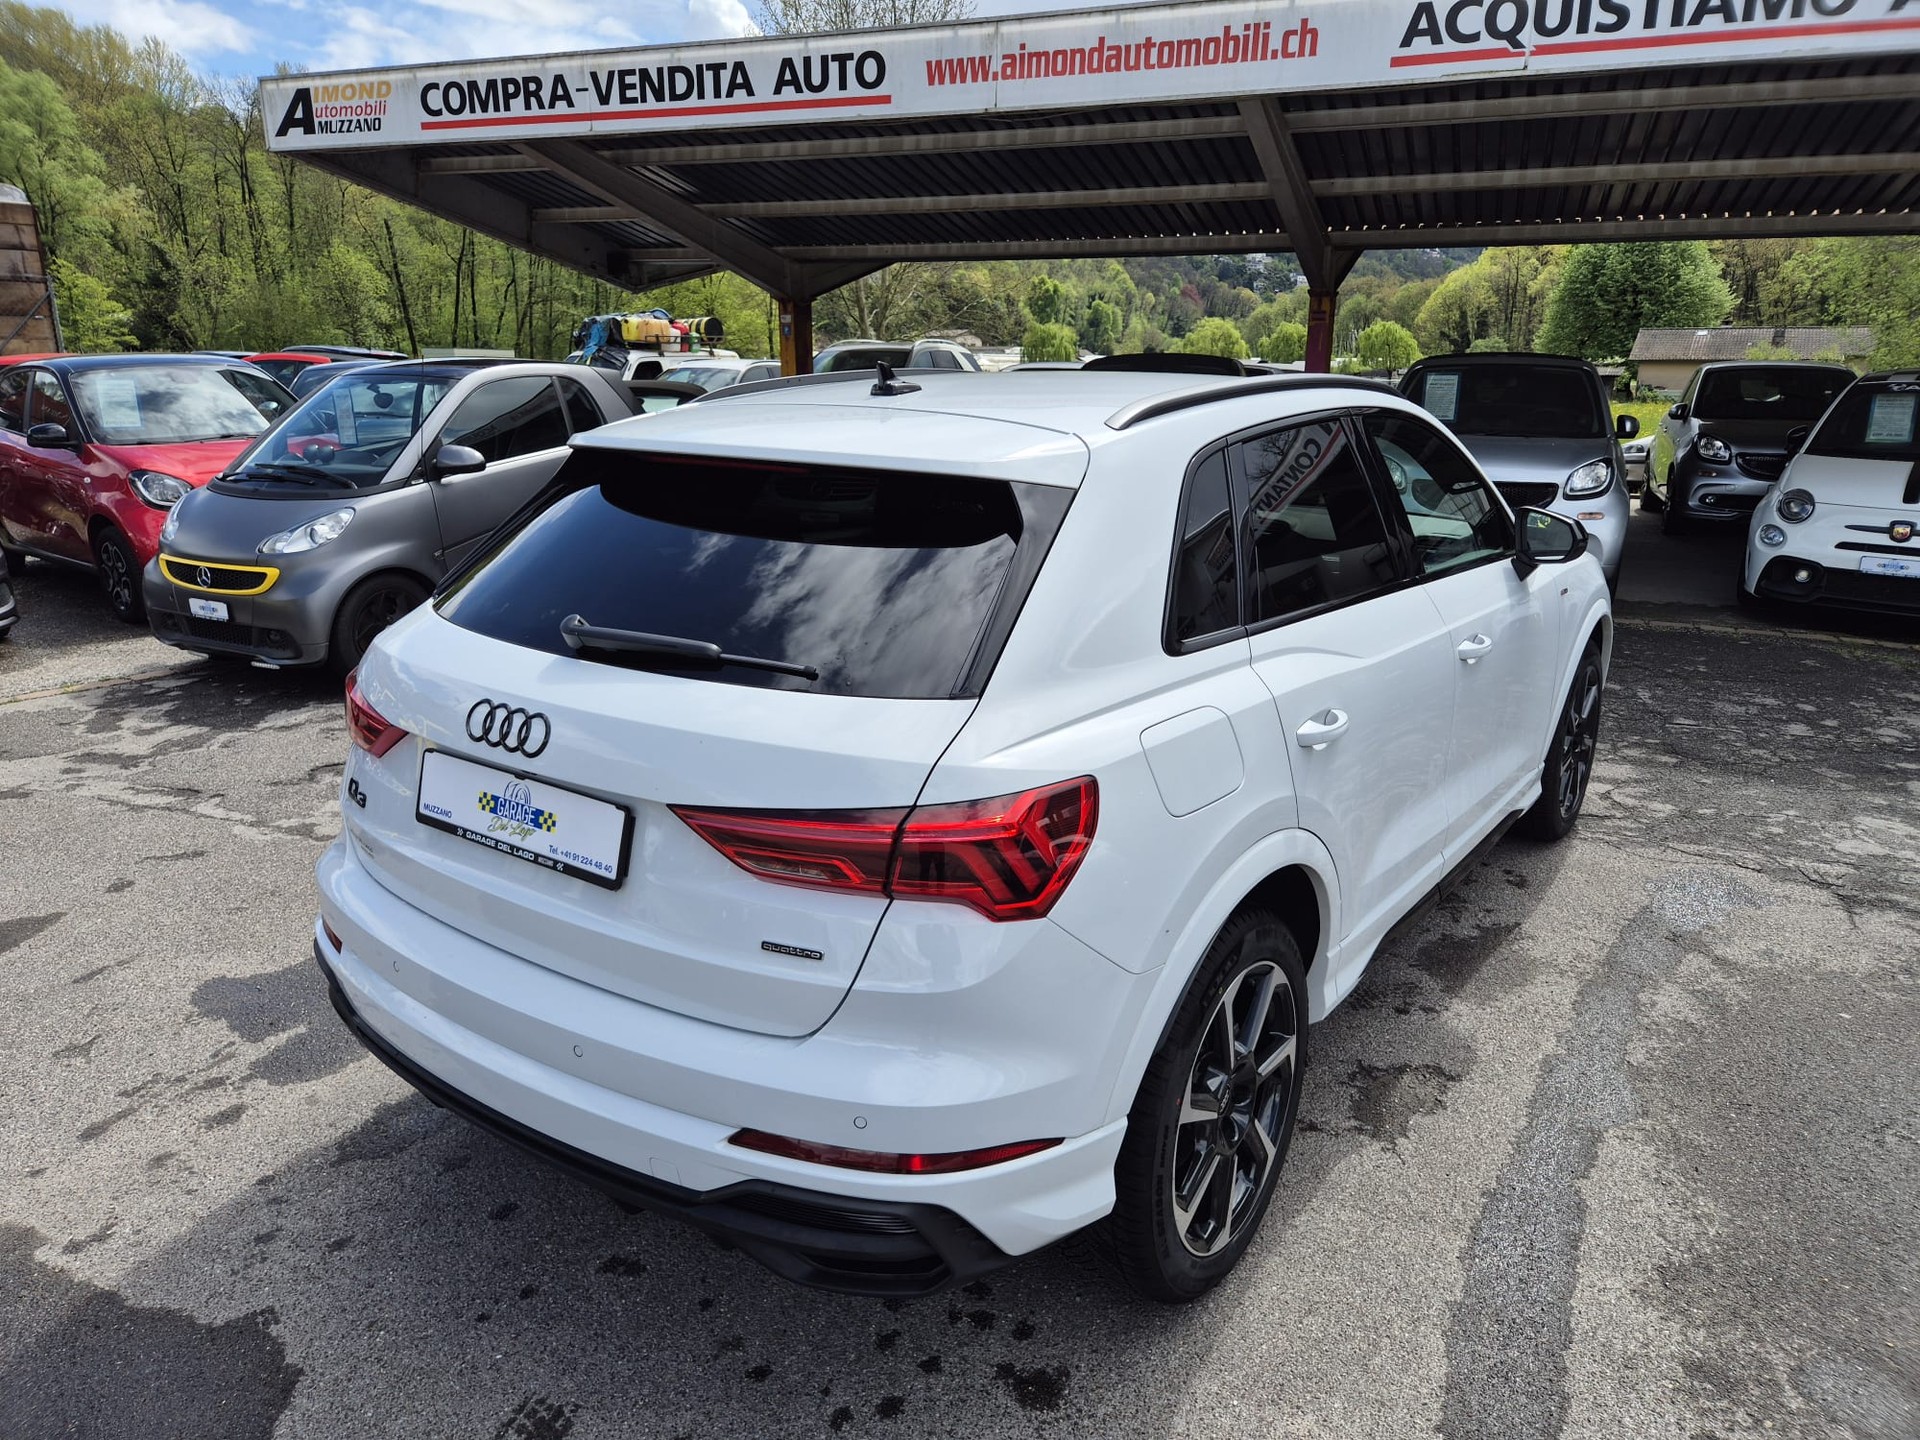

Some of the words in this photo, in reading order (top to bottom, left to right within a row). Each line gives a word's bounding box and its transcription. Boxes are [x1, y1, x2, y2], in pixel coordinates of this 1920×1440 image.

[926, 18, 1319, 86] www.aimondautomobili.ch
[420, 61, 755, 117] COMPRA-VENDITA
[773, 50, 886, 95] AUTO
[317, 117, 382, 134] MUZZANO
[348, 777, 367, 808] Q3
[423, 802, 452, 818] MUZZANO
[497, 798, 536, 825] GARAGE
[466, 831, 496, 846] GARAGE
[498, 842, 512, 853] DEL
[513, 847, 535, 860] LAGO
[549, 844, 559, 856] Tel.
[560, 850, 571, 859] +41
[572, 853, 580, 861] 91
[580, 856, 593, 866] 224
[594, 861, 603, 870] 48
[604, 864, 613, 873] 40
[763, 943, 820, 959] quattro
